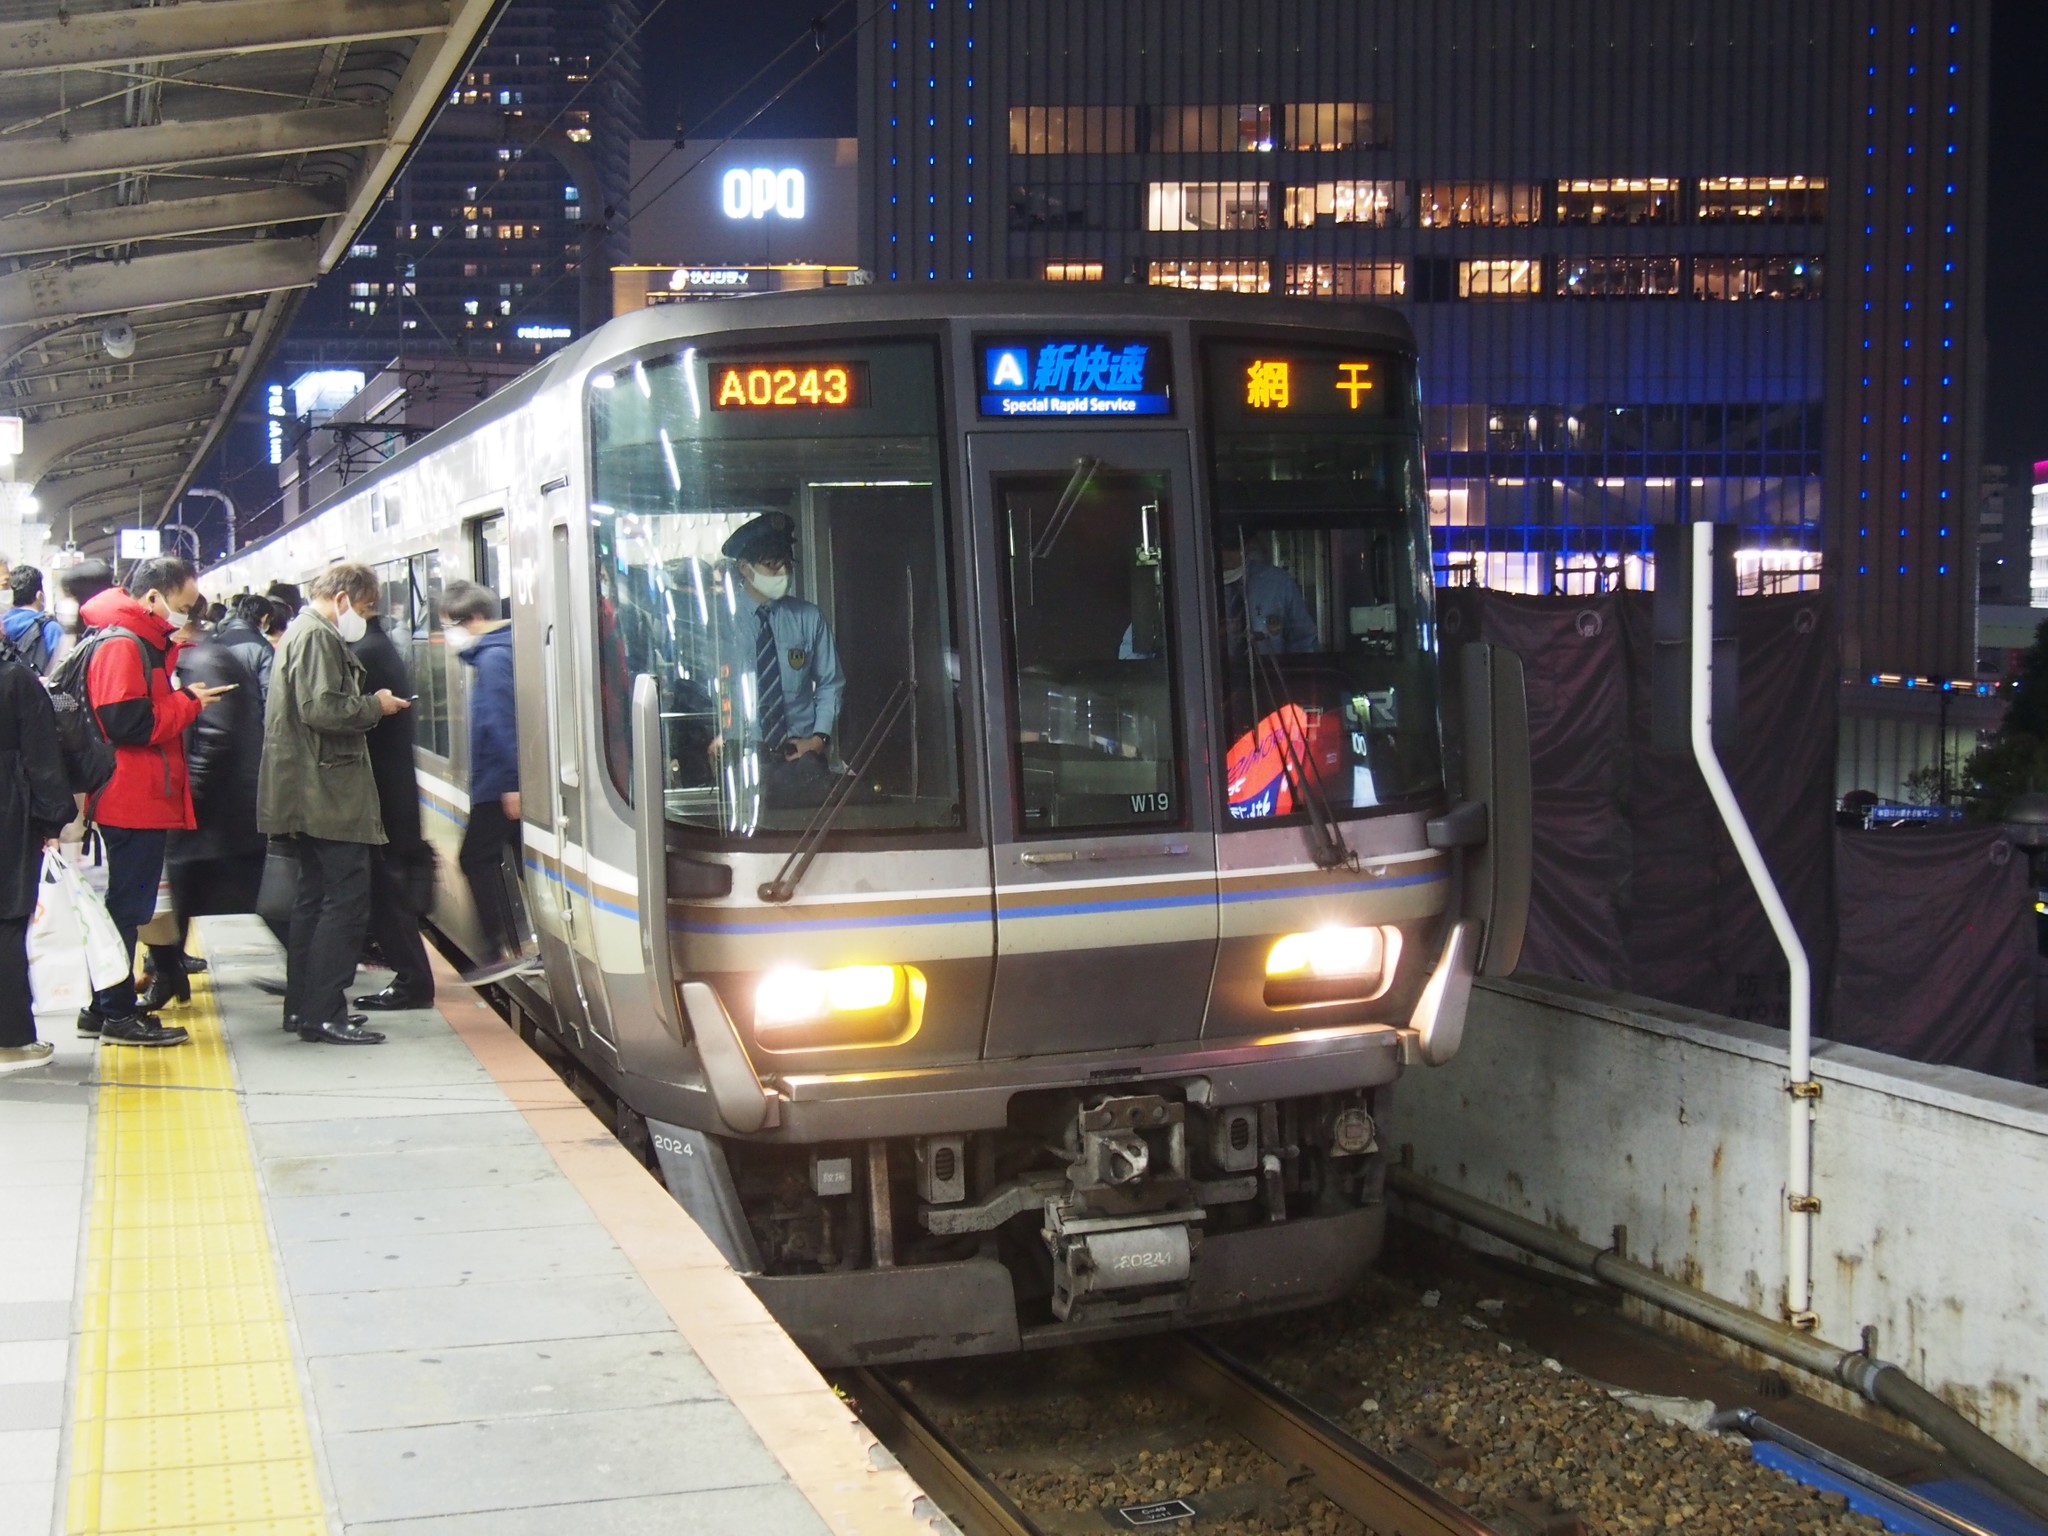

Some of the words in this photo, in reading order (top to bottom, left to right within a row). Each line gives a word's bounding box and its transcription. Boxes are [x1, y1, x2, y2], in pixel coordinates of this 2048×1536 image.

[993, 353, 1024, 386] A
[1033, 344, 1149, 391] 新快速
[719, 368, 848, 406] A0243
[1002, 398, 1048, 414] Special
[1050, 398, 1088, 414] Rapid
[1090, 397, 1136, 412] Service
[134, 535, 146, 552] 4
[1131, 793, 1169, 812] W19
[654, 1134, 694, 1157] 2024
